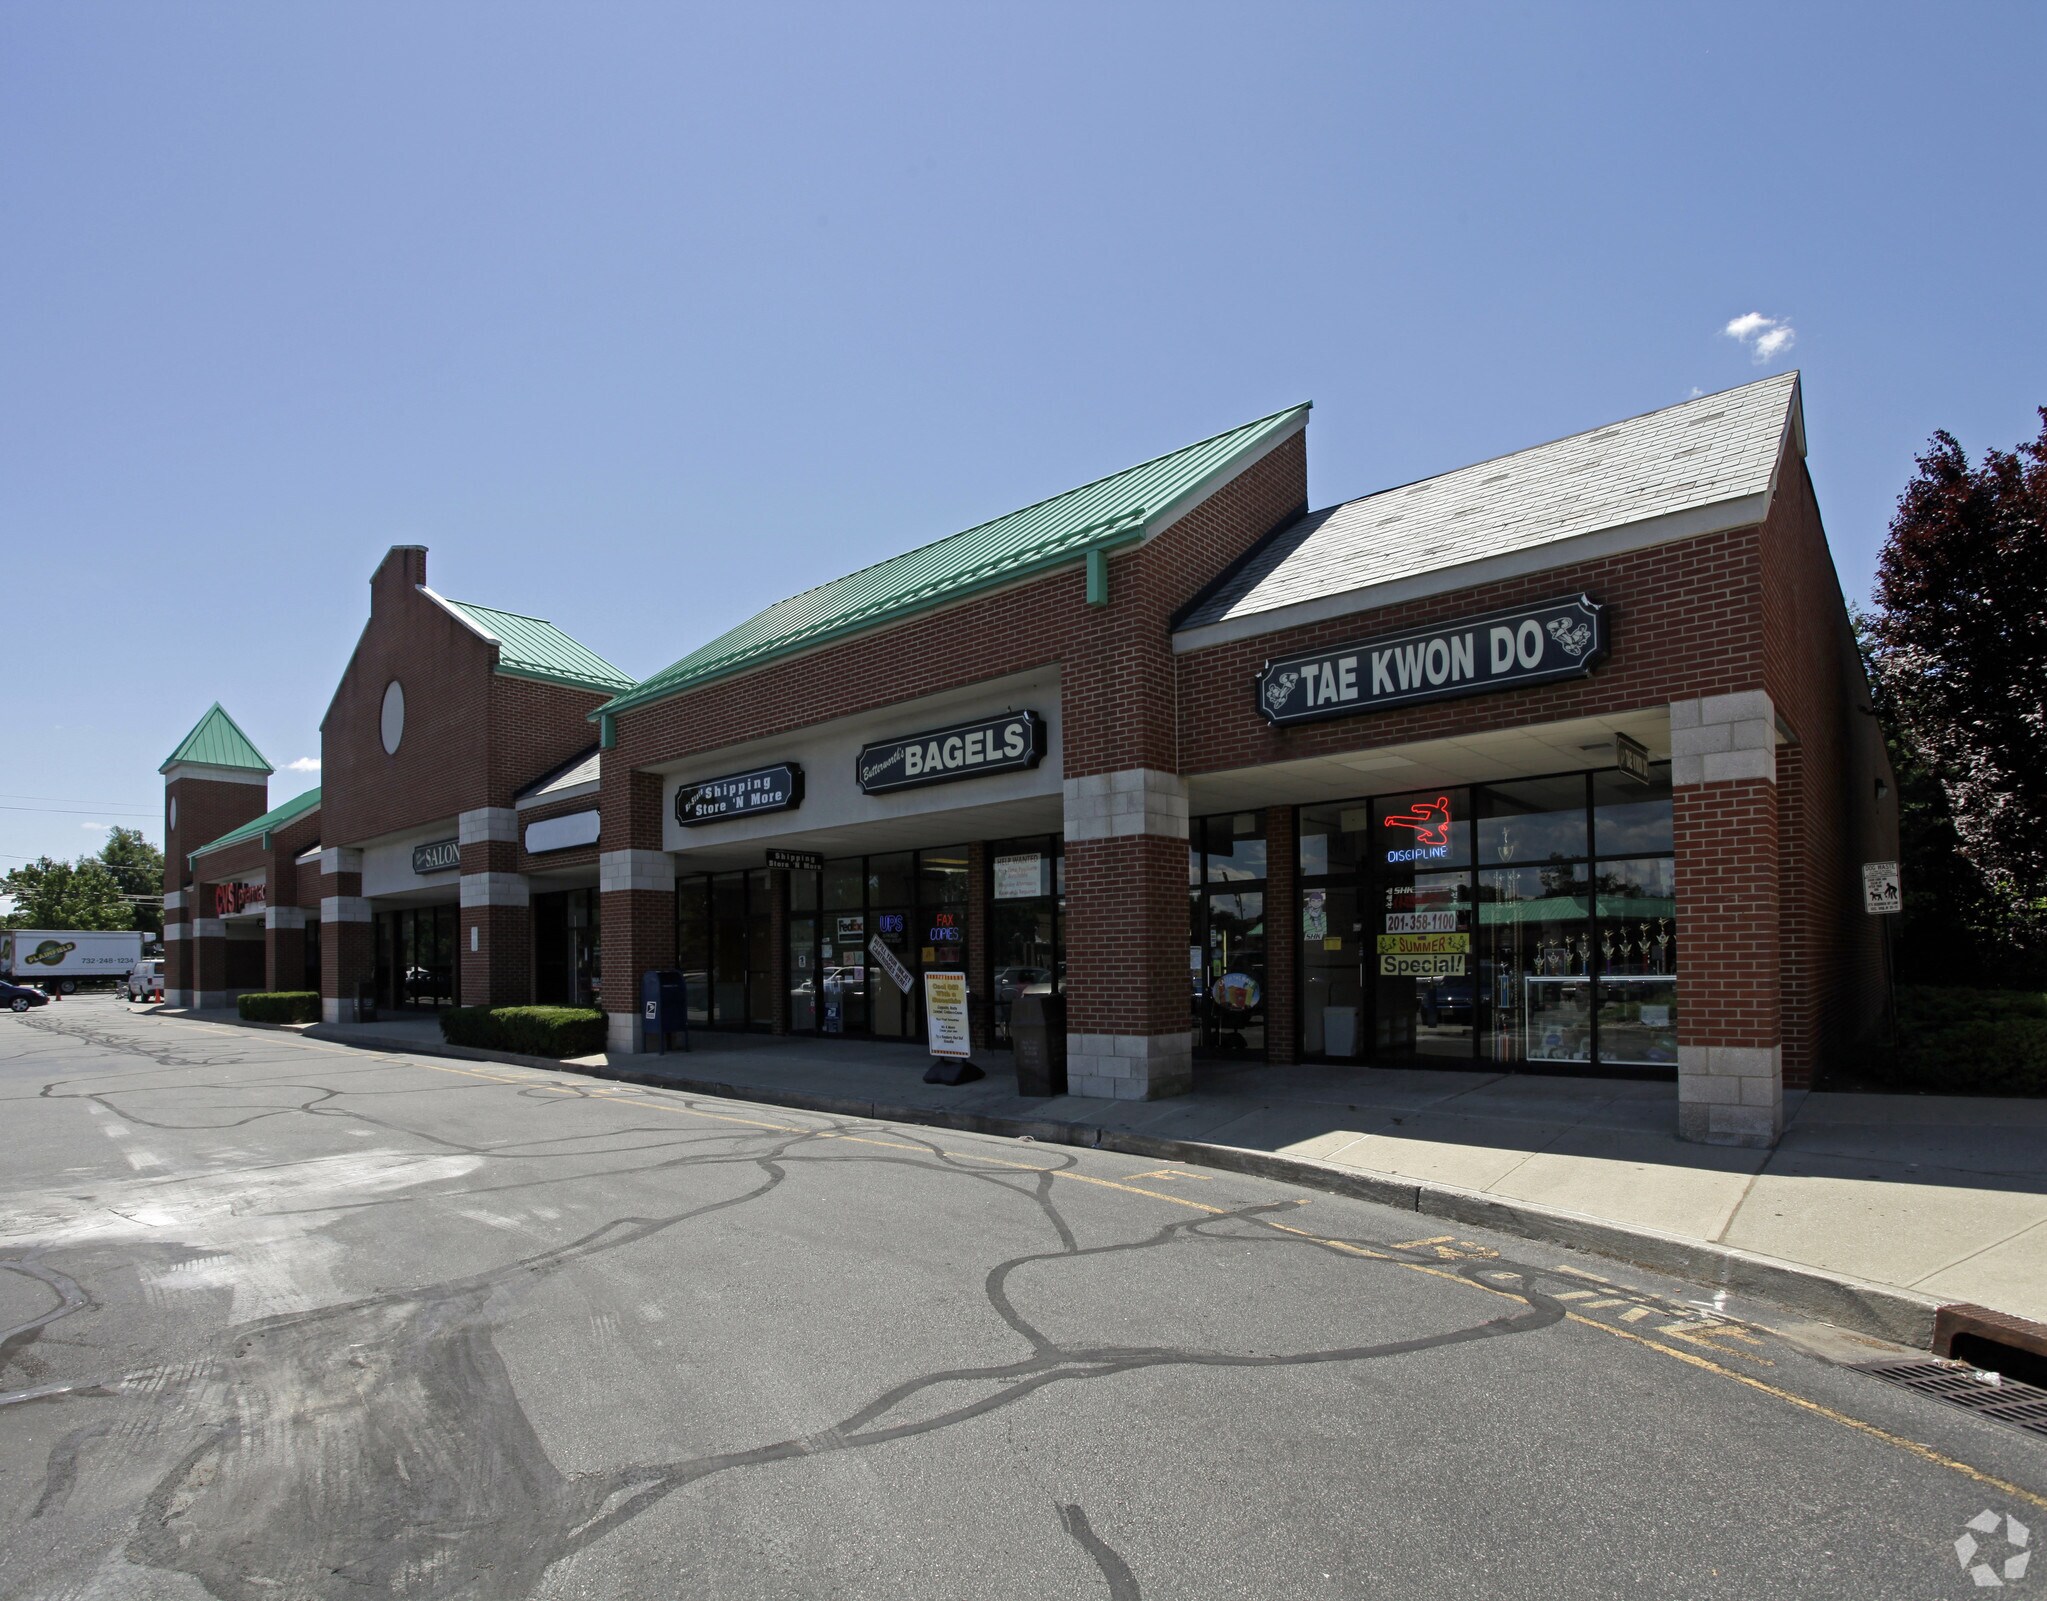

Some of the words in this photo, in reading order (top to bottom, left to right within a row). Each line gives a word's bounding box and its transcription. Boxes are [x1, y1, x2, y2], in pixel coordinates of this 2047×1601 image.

[1300, 656, 1358, 707] TAE
[1372, 632, 1474, 695] KWON
[1489, 619, 1544, 674] DO
[862, 747, 904, 781] Butterworth's
[904, 723, 1025, 776] BAGELS
[705, 776, 771, 799] Shipping
[695, 801, 727, 816] Store
[733, 795, 744, 809] 'N
[750, 790, 782, 806] More
[425, 843, 460, 867] SALON
[775, 852, 816, 864] Shipping
[997, 857, 1012, 866] HELP
[1013, 854, 1039, 865] WANTED
[1387, 845, 1448, 863] DISCIPLINE
[769, 860, 789, 868] Store
[803, 862, 822, 870] More
[215, 882, 235, 913] CVS
[879, 914, 904, 933] UPS
[936, 913, 954, 927] FAX
[1387, 914, 1454, 931] 201-358-1100
[930, 927, 959, 941] COPIES
[27, 943, 73, 963] PLAINFIELD
[1399, 936, 1446, 952] SUMMER
[886, 951, 898, 966] YOUR
[1384, 955, 1463, 975] Special!
